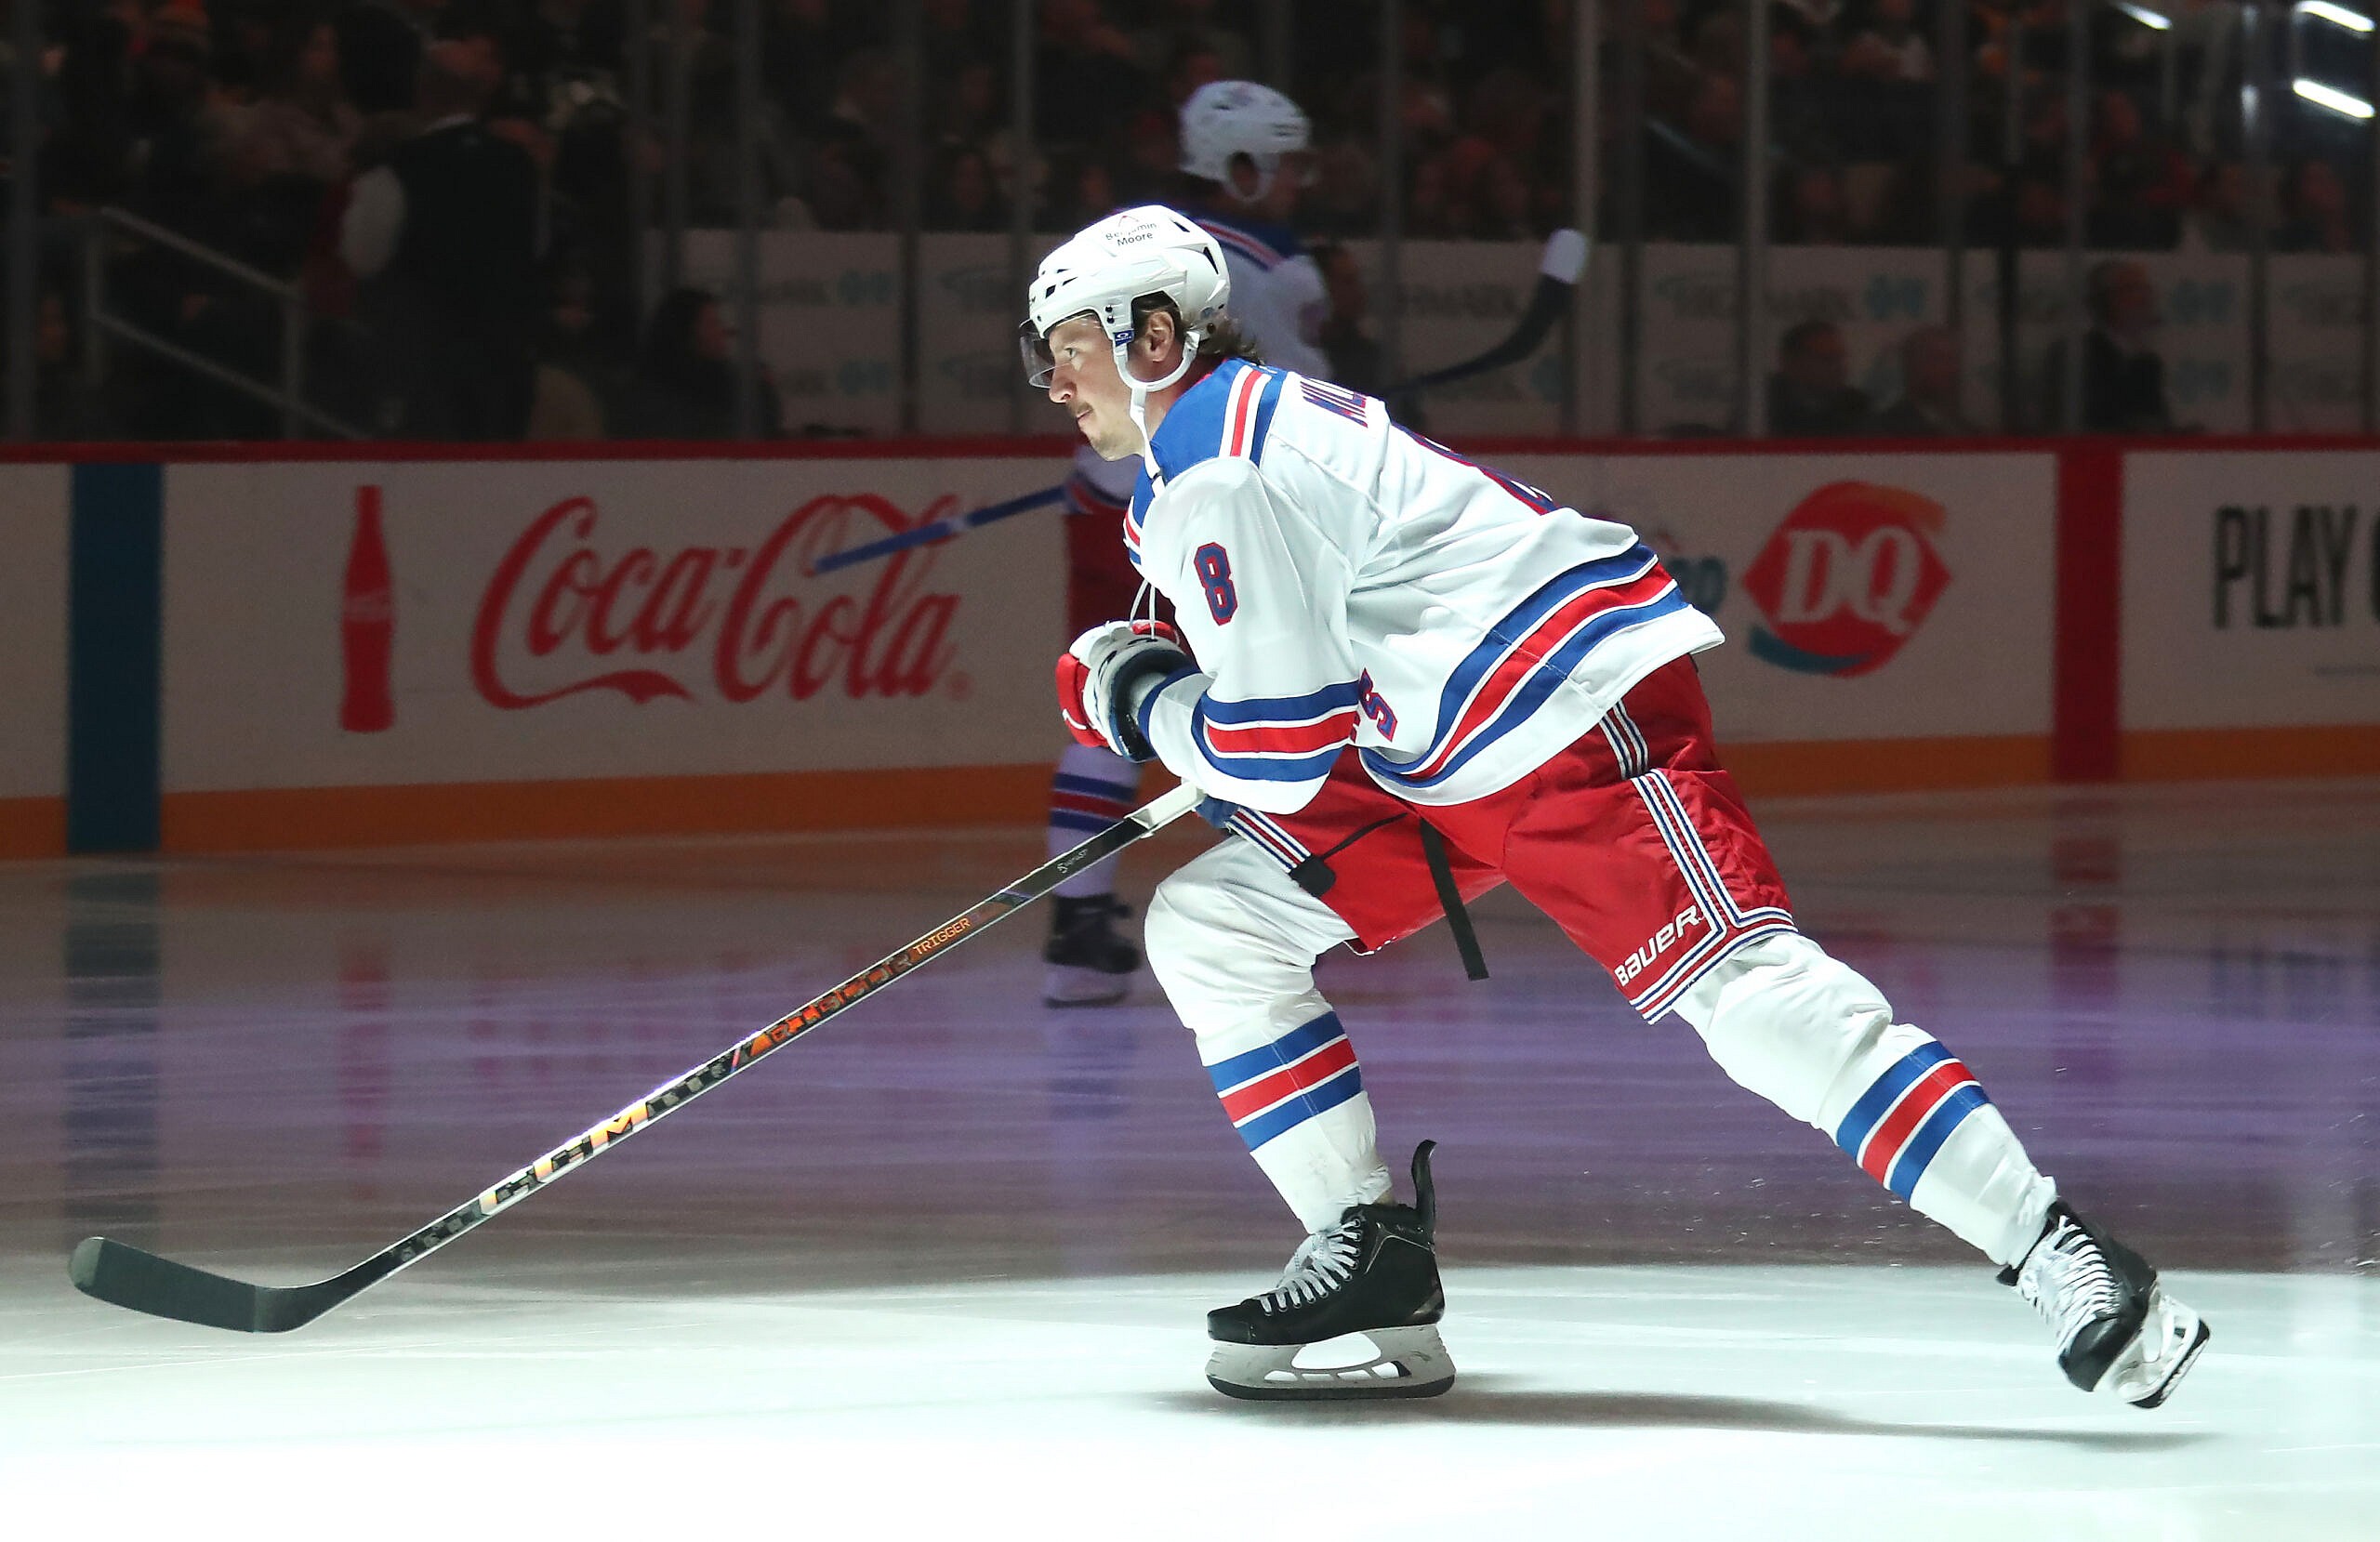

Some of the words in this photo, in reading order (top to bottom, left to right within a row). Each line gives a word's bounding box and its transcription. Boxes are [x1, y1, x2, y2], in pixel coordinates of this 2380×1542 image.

[1105, 222, 1157, 241] Bemin
[1117, 232, 1154, 246] Moore
[470, 494, 961, 709] Coca-Cola
[1194, 542, 1237, 626] 8
[1778, 525, 1922, 635] DQ
[2215, 506, 2359, 628] PLAY
[912, 916, 972, 956] TRIGGER
